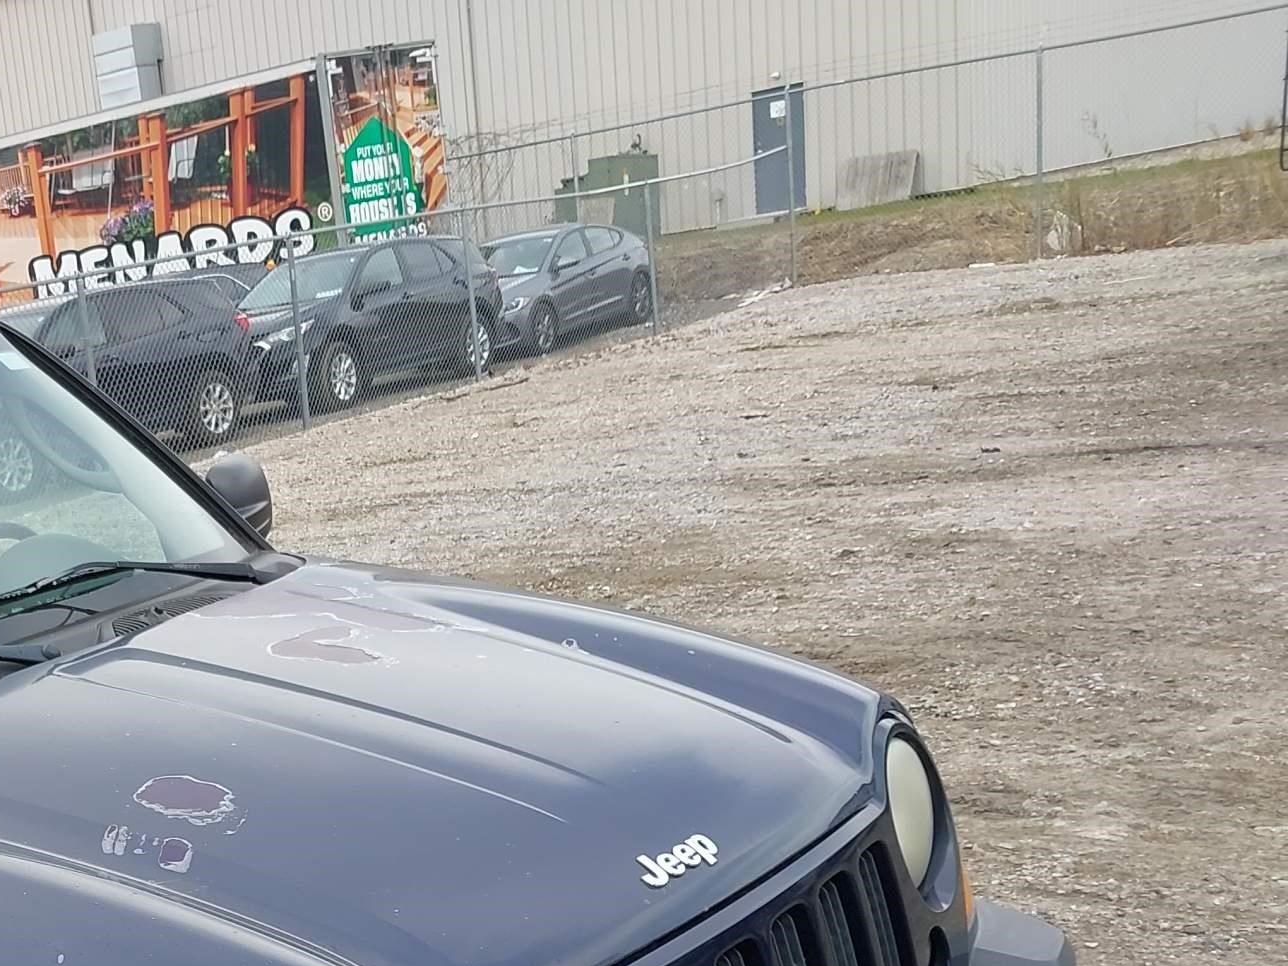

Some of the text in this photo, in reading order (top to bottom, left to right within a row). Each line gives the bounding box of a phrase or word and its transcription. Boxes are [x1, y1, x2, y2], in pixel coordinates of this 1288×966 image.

[356, 145, 372, 158] PUT
[352, 177, 409, 200] WHERE YOUR
[28, 207, 315, 298] MENARDS
[636, 834, 719, 887] Jeep
